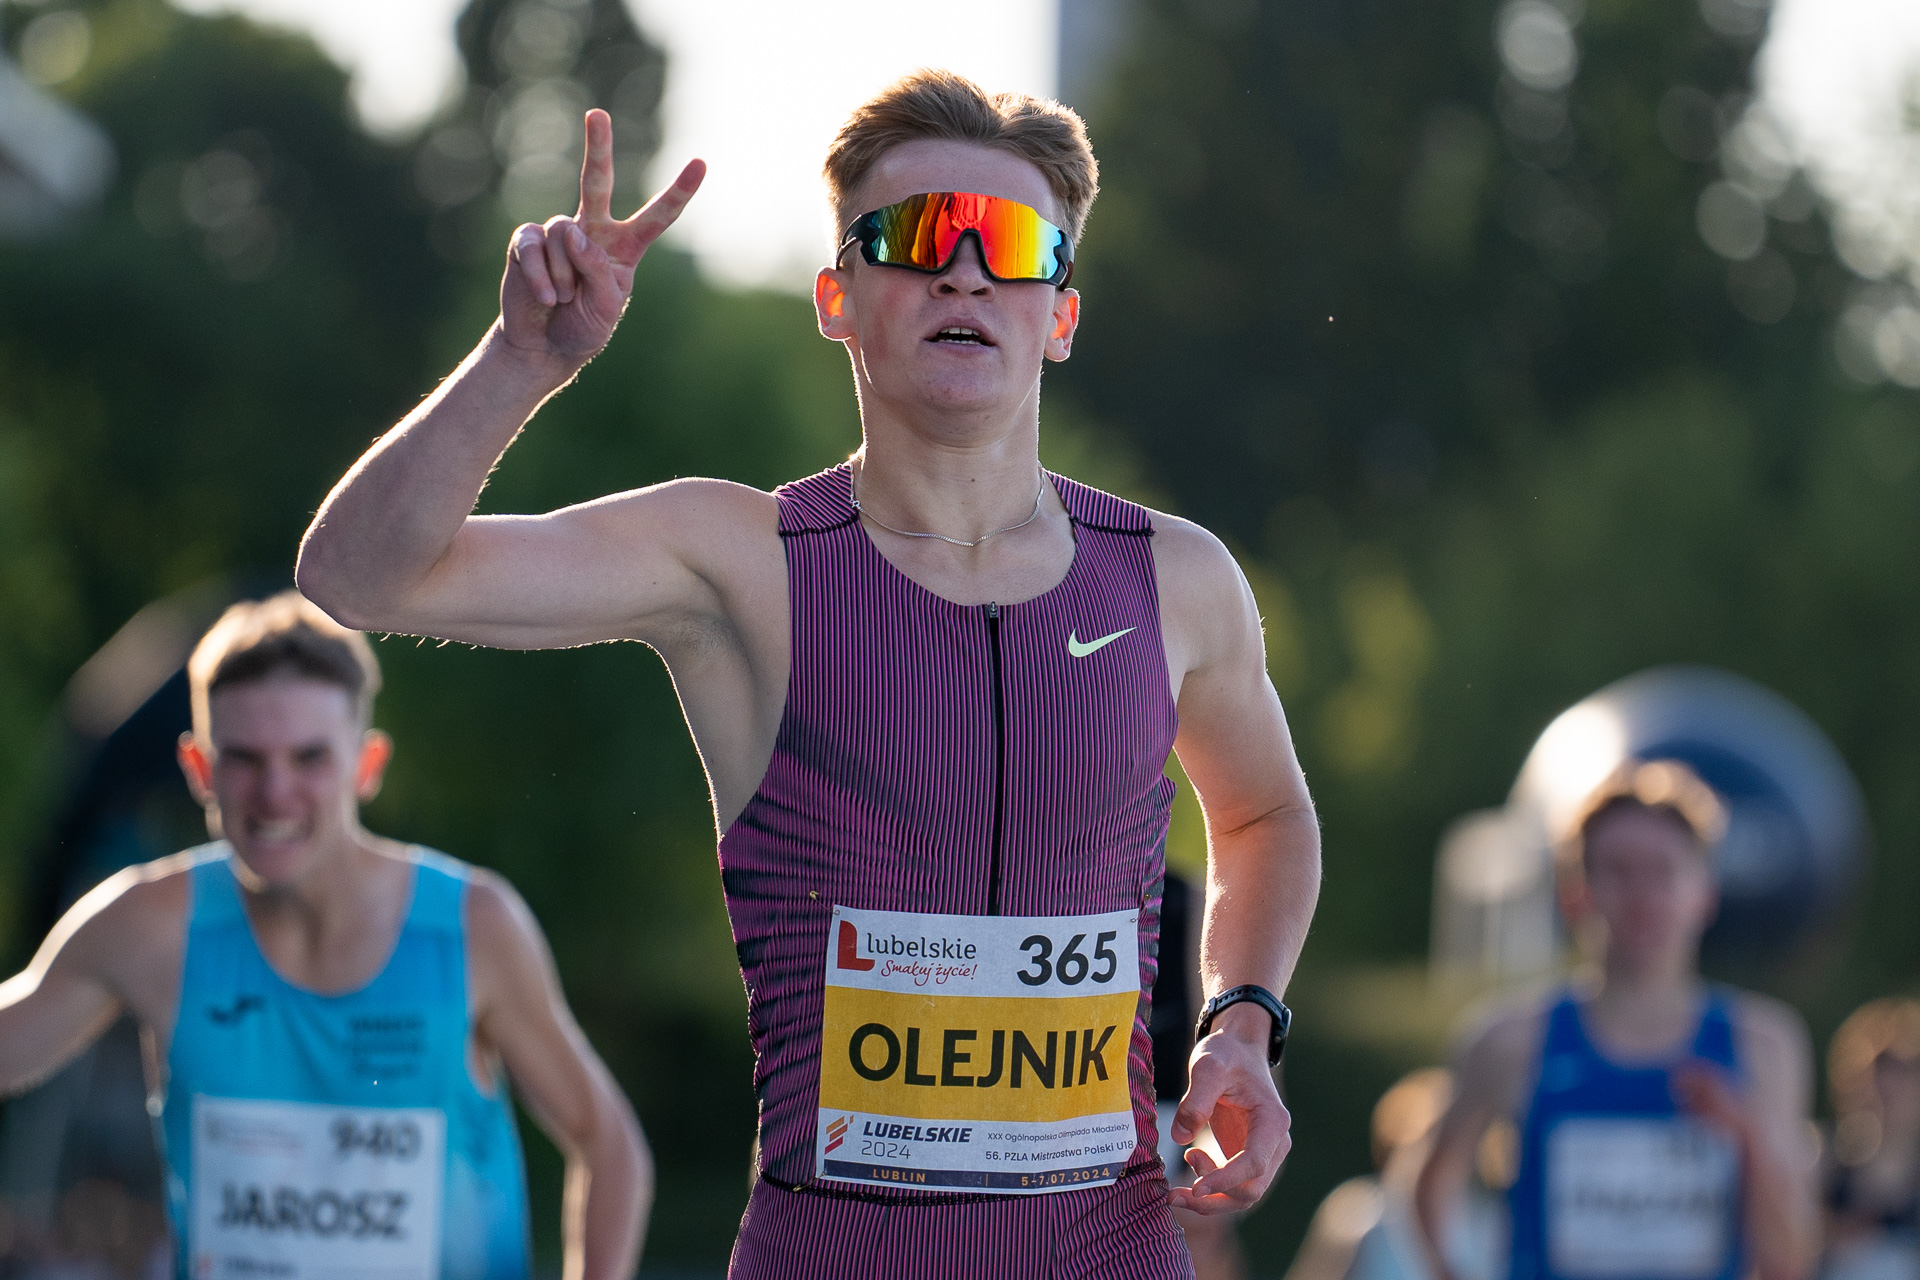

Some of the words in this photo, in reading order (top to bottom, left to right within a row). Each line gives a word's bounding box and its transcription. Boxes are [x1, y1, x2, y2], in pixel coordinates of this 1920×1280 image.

[867, 932, 977, 959] lubelskie
[1016, 930, 1118, 986] 365
[881, 959, 935, 987] Smakuj
[935, 963, 978, 985] życie!
[848, 1022, 1118, 1090] OLEJNIK
[862, 1120, 973, 1143] LUBELSKIE
[987, 1132, 1003, 1140] XXX
[1004, 1131, 1058, 1143] Ogólnopolska
[1058, 1127, 1091, 1139] Olimpiada
[861, 1139, 911, 1160] 2024
[985, 1150, 1002, 1161] 56.
[1004, 1151, 1029, 1162] PZLA
[1031, 1147, 1082, 1162] Mistrzostwa
[1084, 1142, 1115, 1156] Polski
[1116, 1139, 1134, 1151] U18
[873, 1168, 926, 1183] LUBLIN
[1021, 1167, 1110, 1187] 5-7.07.2024
[217, 1181, 409, 1241] JAROSZ
